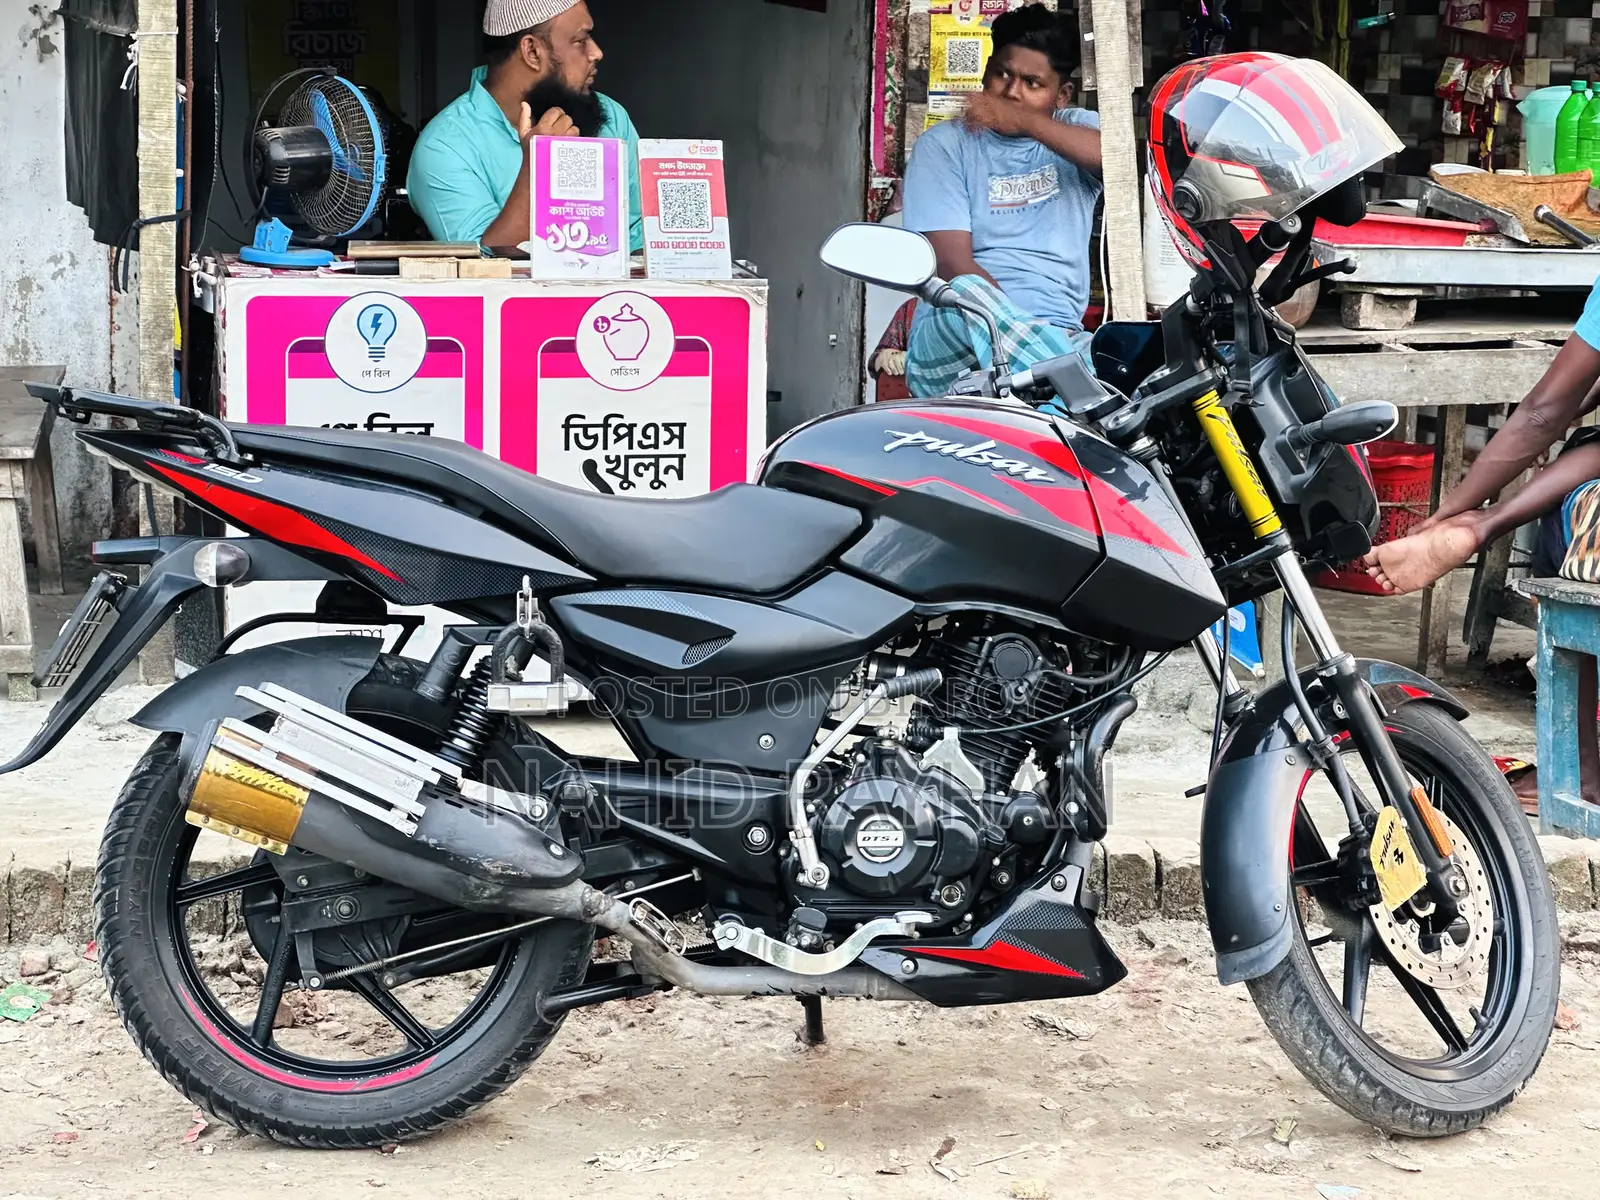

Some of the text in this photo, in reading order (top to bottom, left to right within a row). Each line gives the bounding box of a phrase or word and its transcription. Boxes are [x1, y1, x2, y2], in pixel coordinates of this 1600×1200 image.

[549, 205, 605, 217] ক্যাশ আউট
[362, 367, 391, 378] পে বিল
[610, 366, 640, 377] সেভিংস
[562, 413, 687, 452] ডিপিএস
[202, 463, 264, 484] 150
[603, 454, 687, 489] খুলুন
[177, 1037, 260, 1098] MRF
